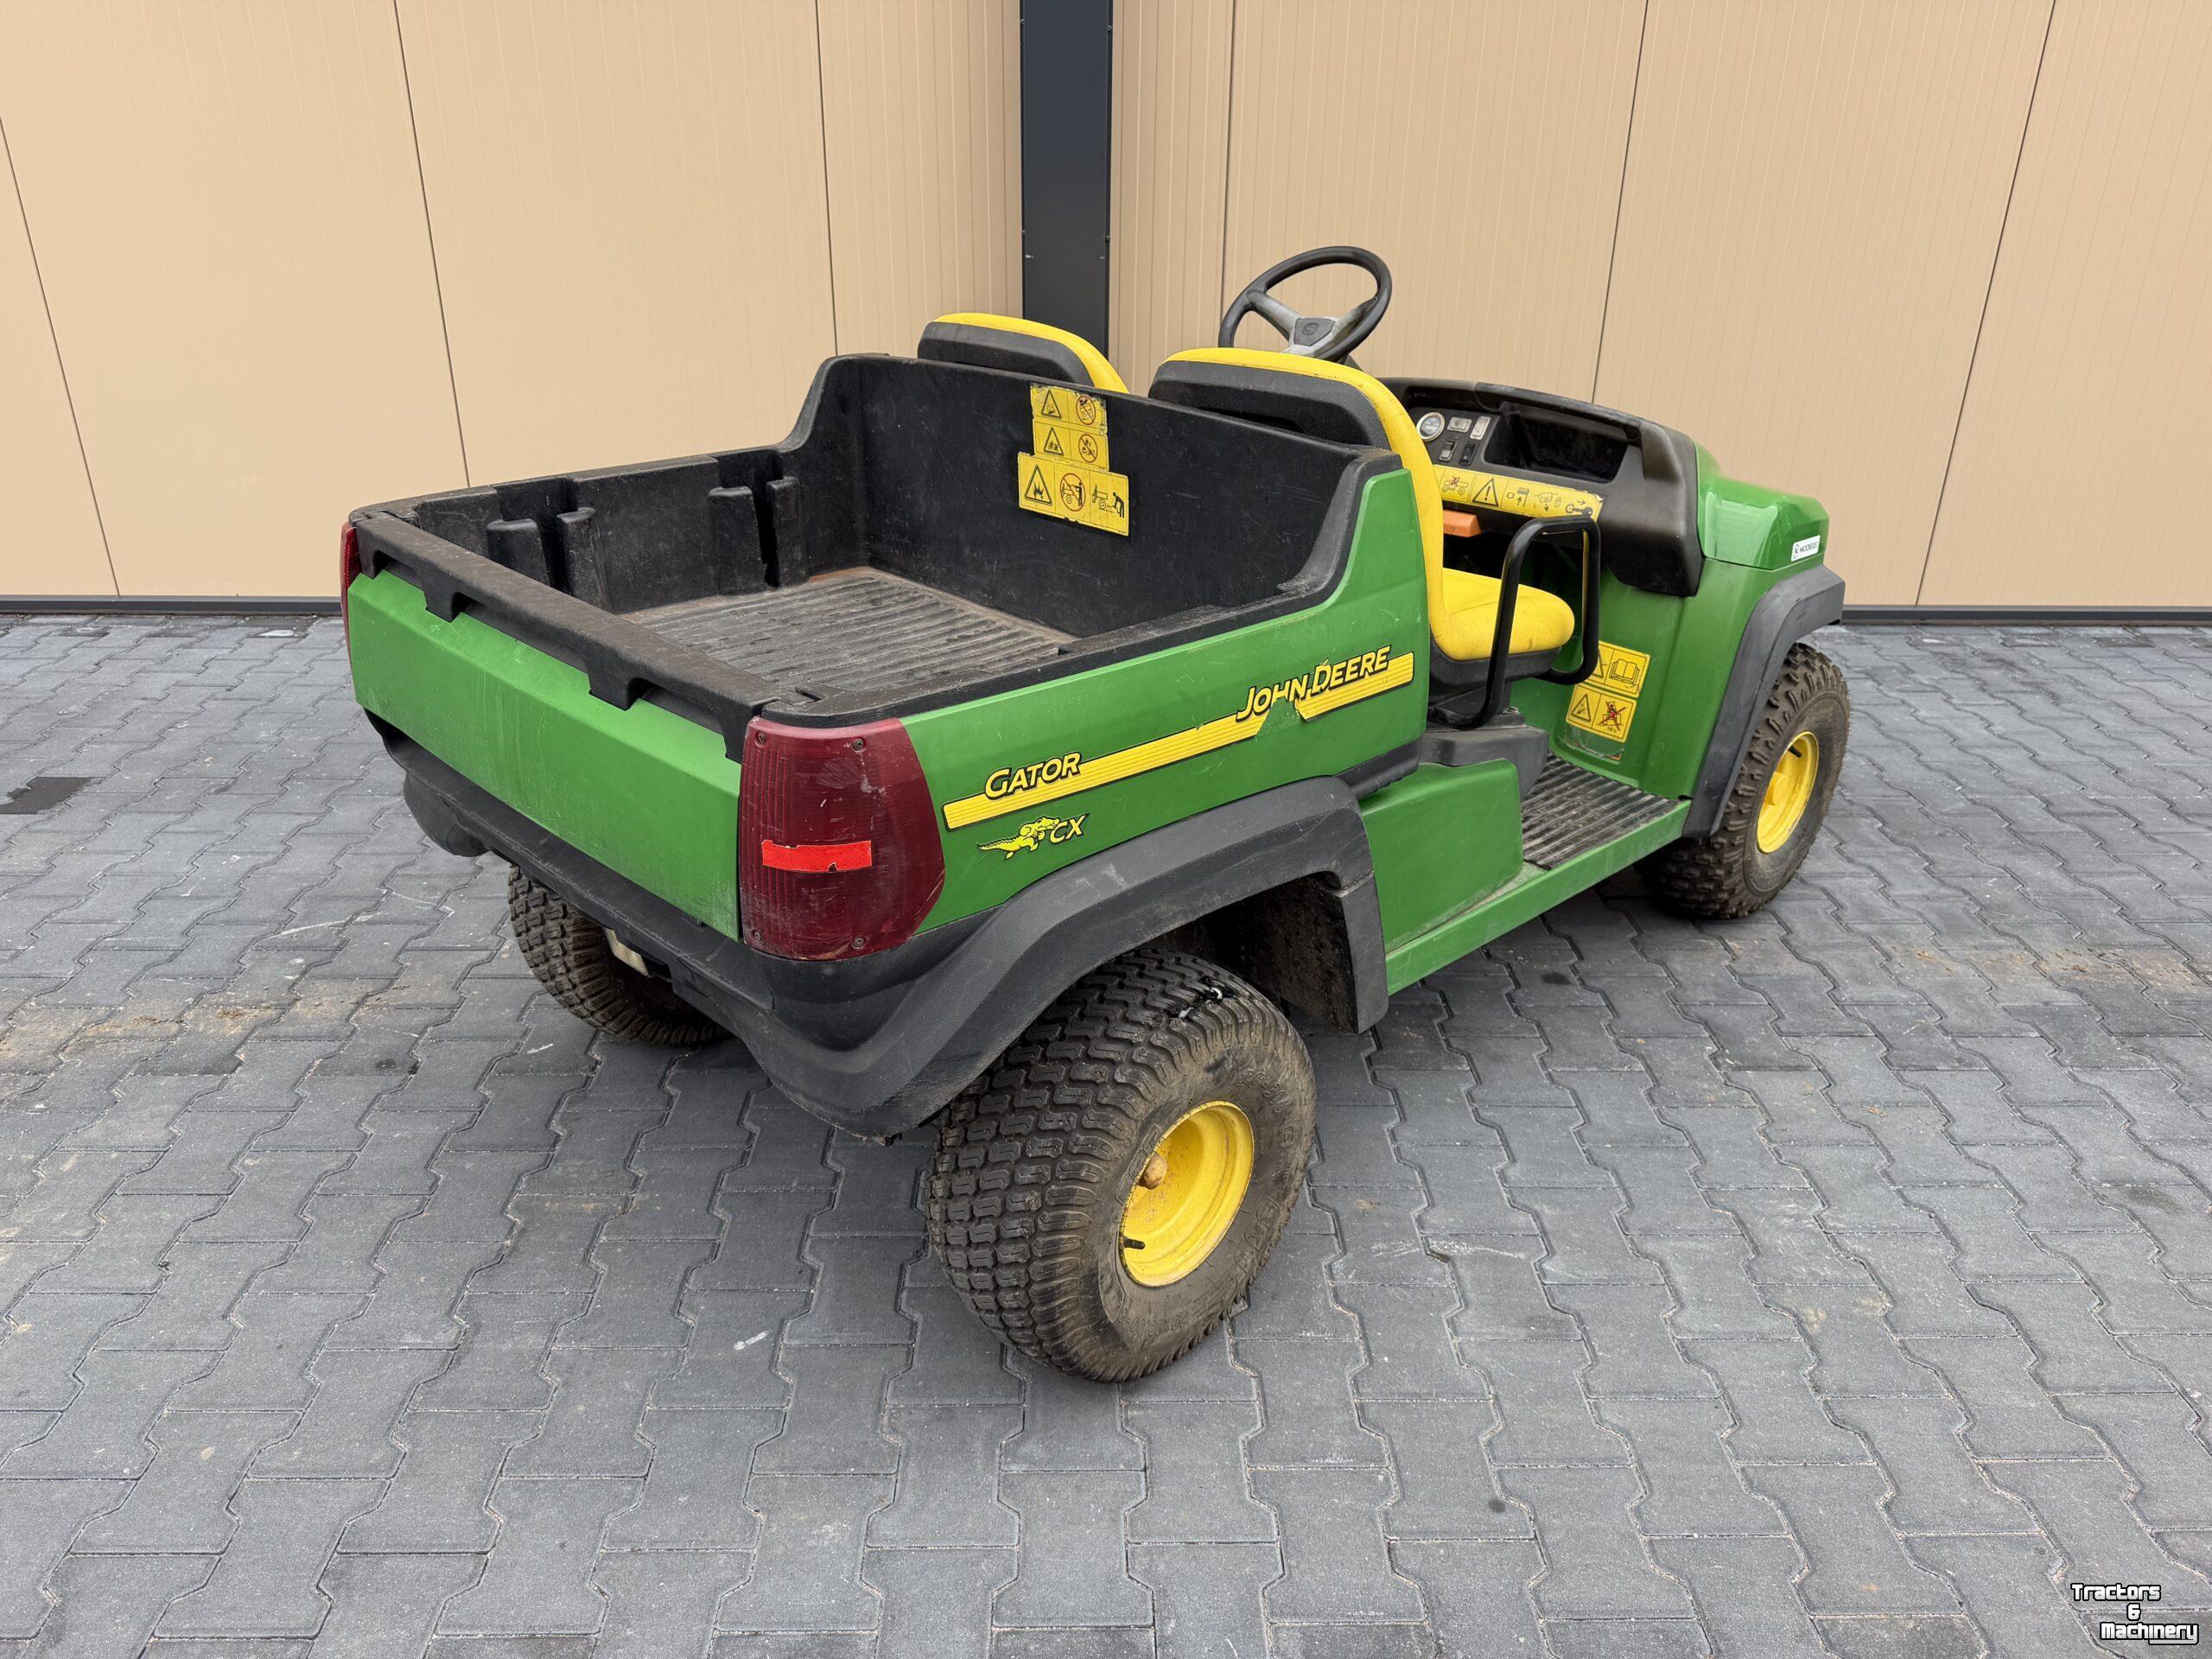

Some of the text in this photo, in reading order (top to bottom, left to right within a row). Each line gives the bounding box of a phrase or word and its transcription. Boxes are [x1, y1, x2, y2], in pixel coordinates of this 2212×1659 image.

[1236, 645, 1391, 722] JOHN DEERE
[985, 752, 1082, 800] GATOR
[1049, 814, 1089, 845] CX
